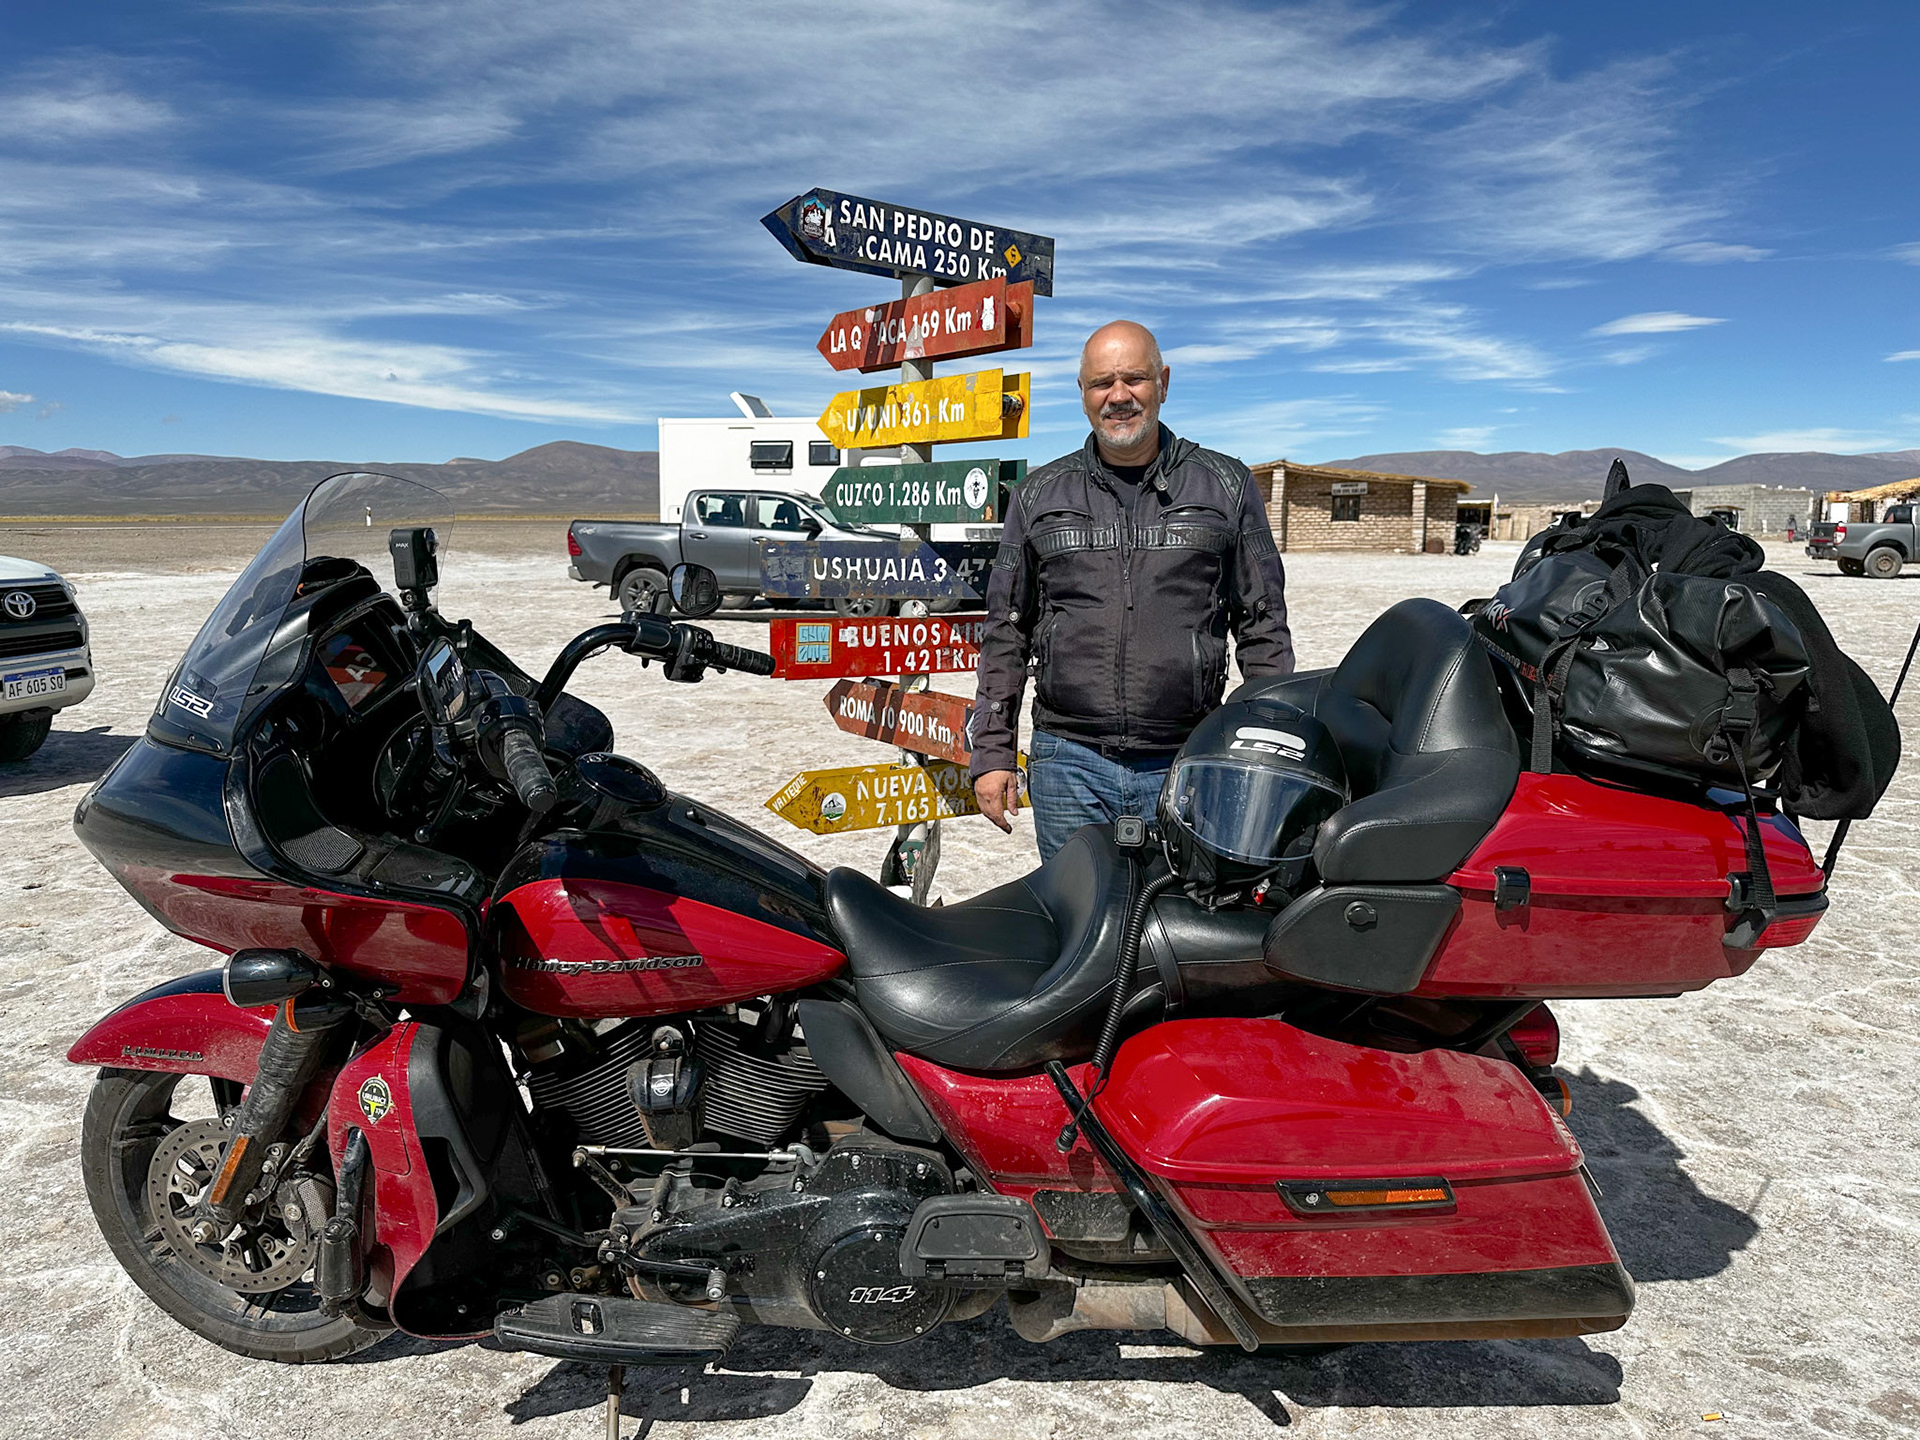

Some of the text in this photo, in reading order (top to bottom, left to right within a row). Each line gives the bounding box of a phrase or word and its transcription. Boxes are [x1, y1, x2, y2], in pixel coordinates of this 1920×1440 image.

[840, 200, 885, 232] SAN
[894, 211, 962, 247] PEDRO
[970, 228, 995, 254] DE
[934, 249, 970, 278] 250
[977, 257, 1007, 280] Km
[830, 305, 972, 354] LA QACA 169 Km
[846, 398, 965, 432] UYUNI 361 Km
[836, 480, 962, 507] CUZCO 1.286 Km
[813, 556, 926, 582] USHUAIA
[847, 622, 941, 649] BUENOS
[949, 621, 984, 644] AIR
[883, 647, 981, 673] 1.421 Km
[9, 681, 22, 698] AF
[26, 678, 47, 695] 605
[50, 675, 63, 691] SQ
[839, 695, 877, 725] ROMA
[899, 709, 924, 737] 900
[928, 716, 951, 744] Km
[1229, 740, 1306, 762] LS2
[857, 765, 973, 801] NUEVA YOR
[876, 799, 930, 825] 7.165
[848, 1285, 916, 1304] 114
